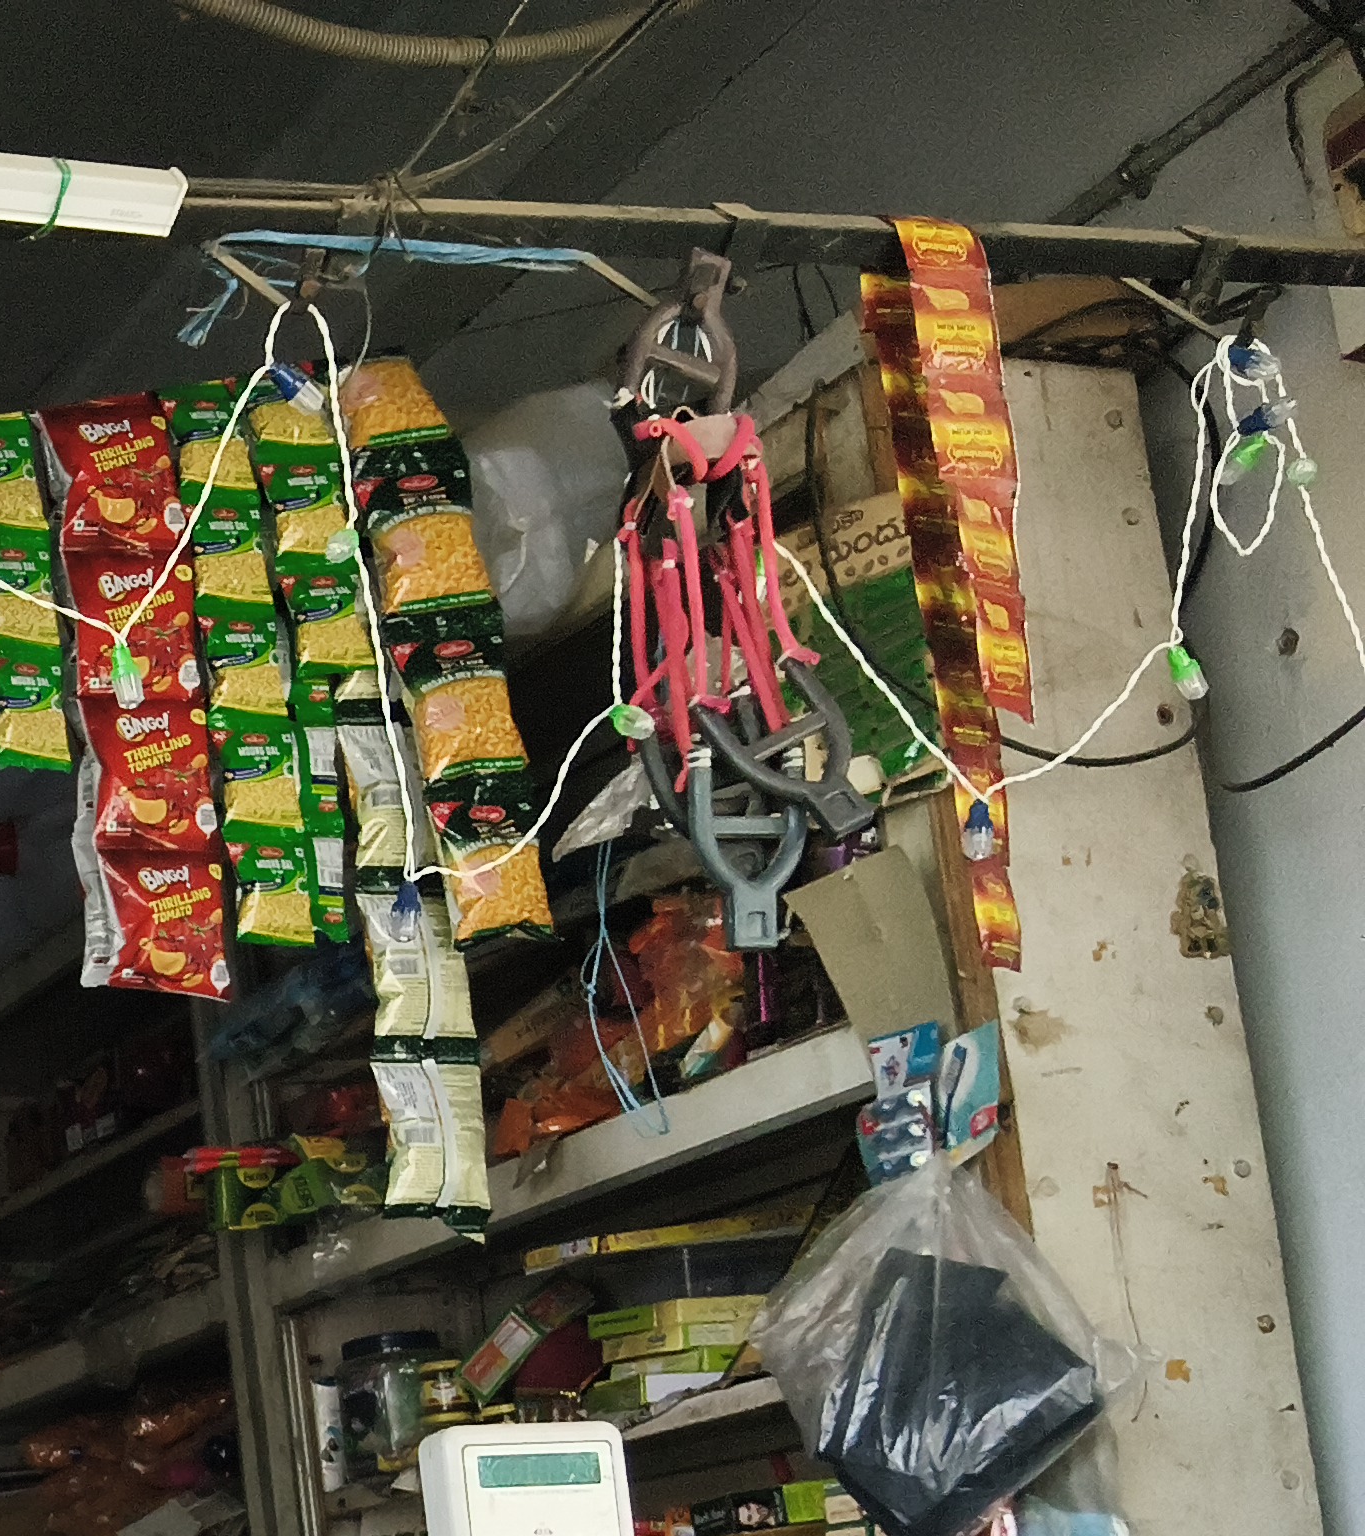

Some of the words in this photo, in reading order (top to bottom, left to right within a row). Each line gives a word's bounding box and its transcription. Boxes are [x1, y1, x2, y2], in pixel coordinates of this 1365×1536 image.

[79, 420, 134, 443] BINGO!
[89, 436, 155, 463] THRILLING
[95, 453, 138, 473] TOMATO
[100, 567, 154, 598] BINGO!
[118, 711, 170, 738] BINGO!
[123, 733, 192, 763] THRILLING
[127, 752, 173, 774] TOMATO
[139, 866, 190, 890] BINGO!
[148, 886, 212, 914] THRILLING
[152, 903, 194, 924] TOMATO
